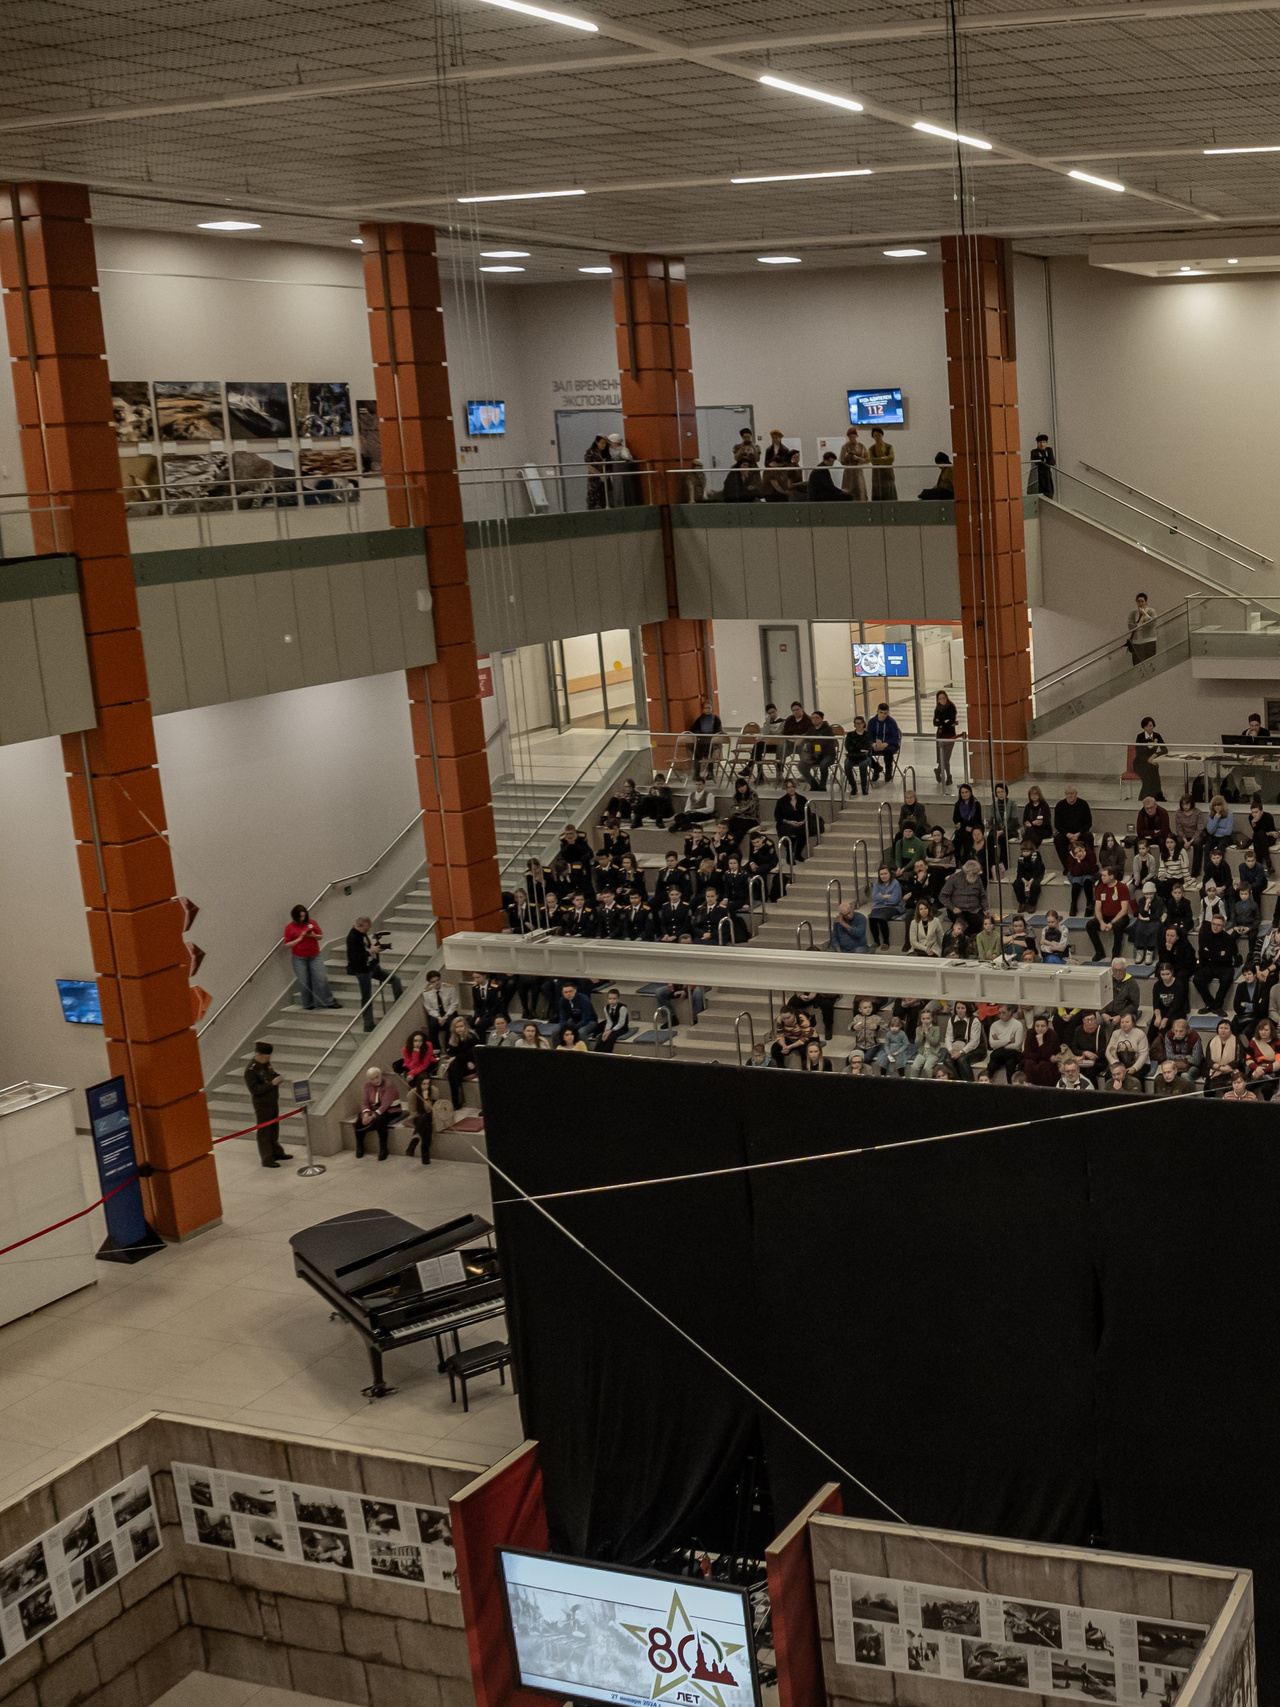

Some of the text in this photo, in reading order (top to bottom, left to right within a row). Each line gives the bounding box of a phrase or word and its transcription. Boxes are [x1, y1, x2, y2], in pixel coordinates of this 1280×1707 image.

[552, 380, 573, 392] ЗАЛ
[868, 405, 884, 415] 112
[676, 1691, 700, 1704] ЛЕТ
